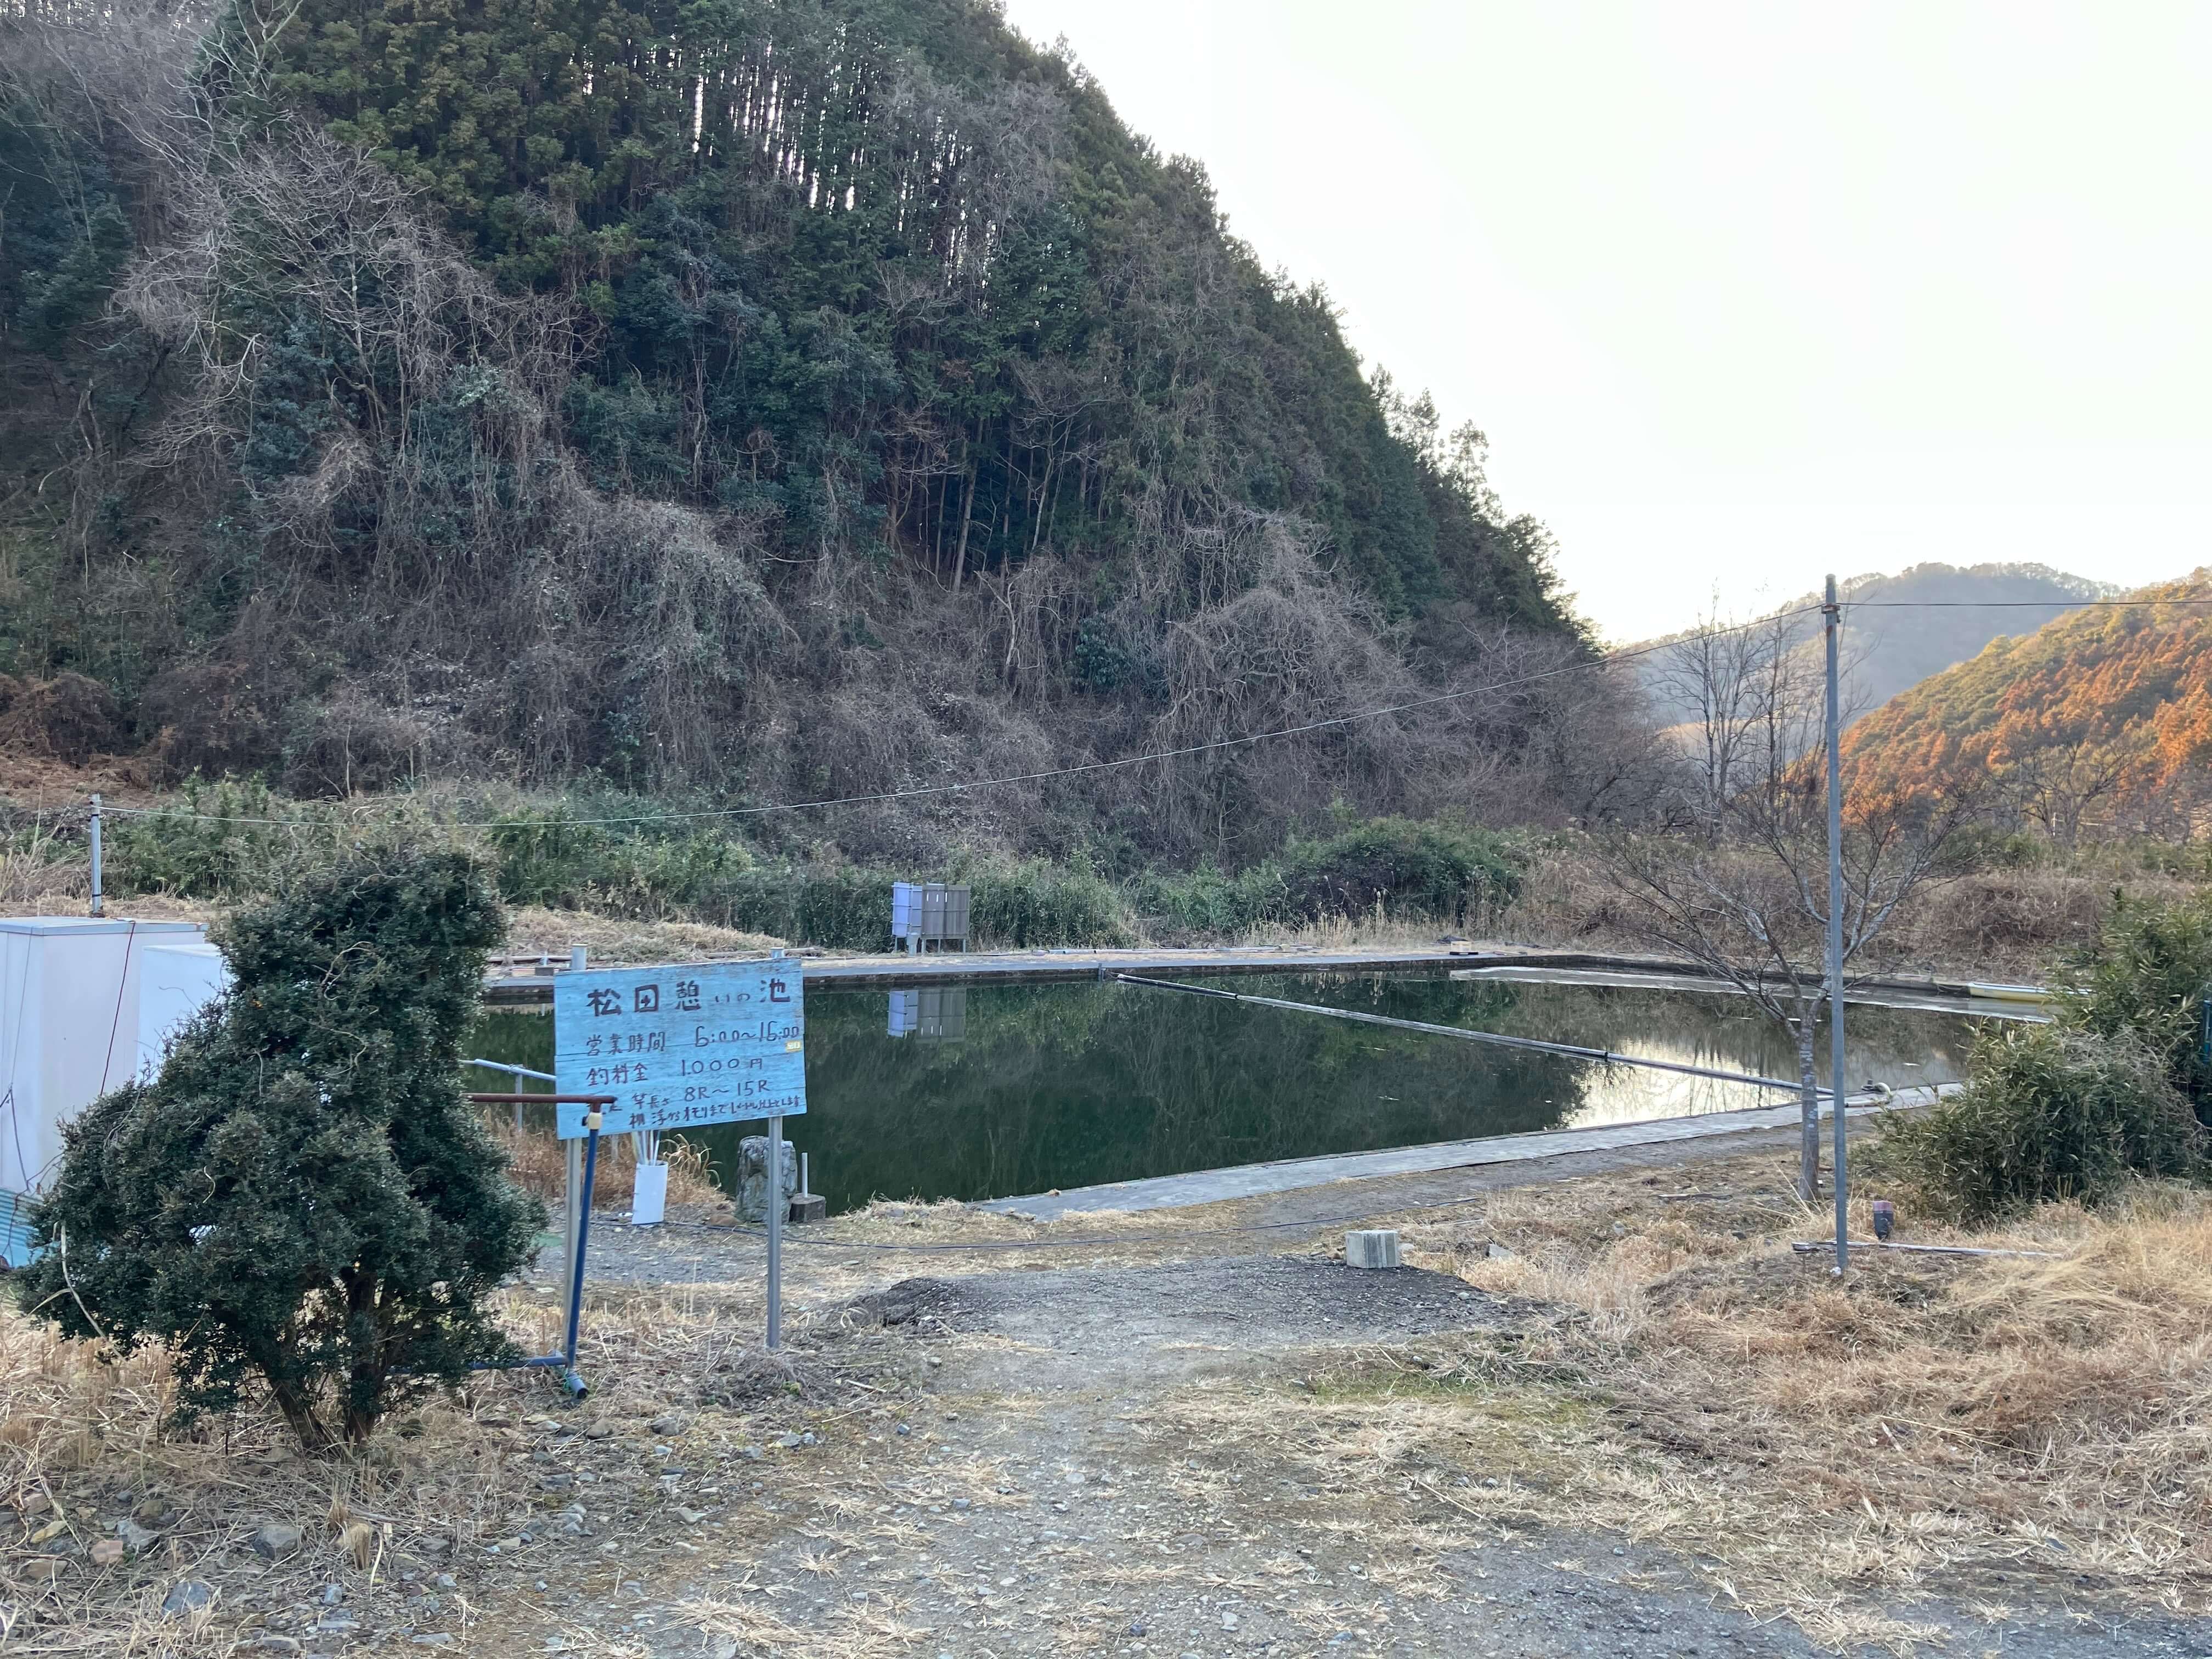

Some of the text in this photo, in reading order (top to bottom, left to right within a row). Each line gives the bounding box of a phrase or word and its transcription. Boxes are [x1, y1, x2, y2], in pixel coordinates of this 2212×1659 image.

[585, 978, 791, 1017] 松田憩いの池
[586, 1031, 665, 1056] 営業時間
[586, 1062, 648, 1086] 釣料金
